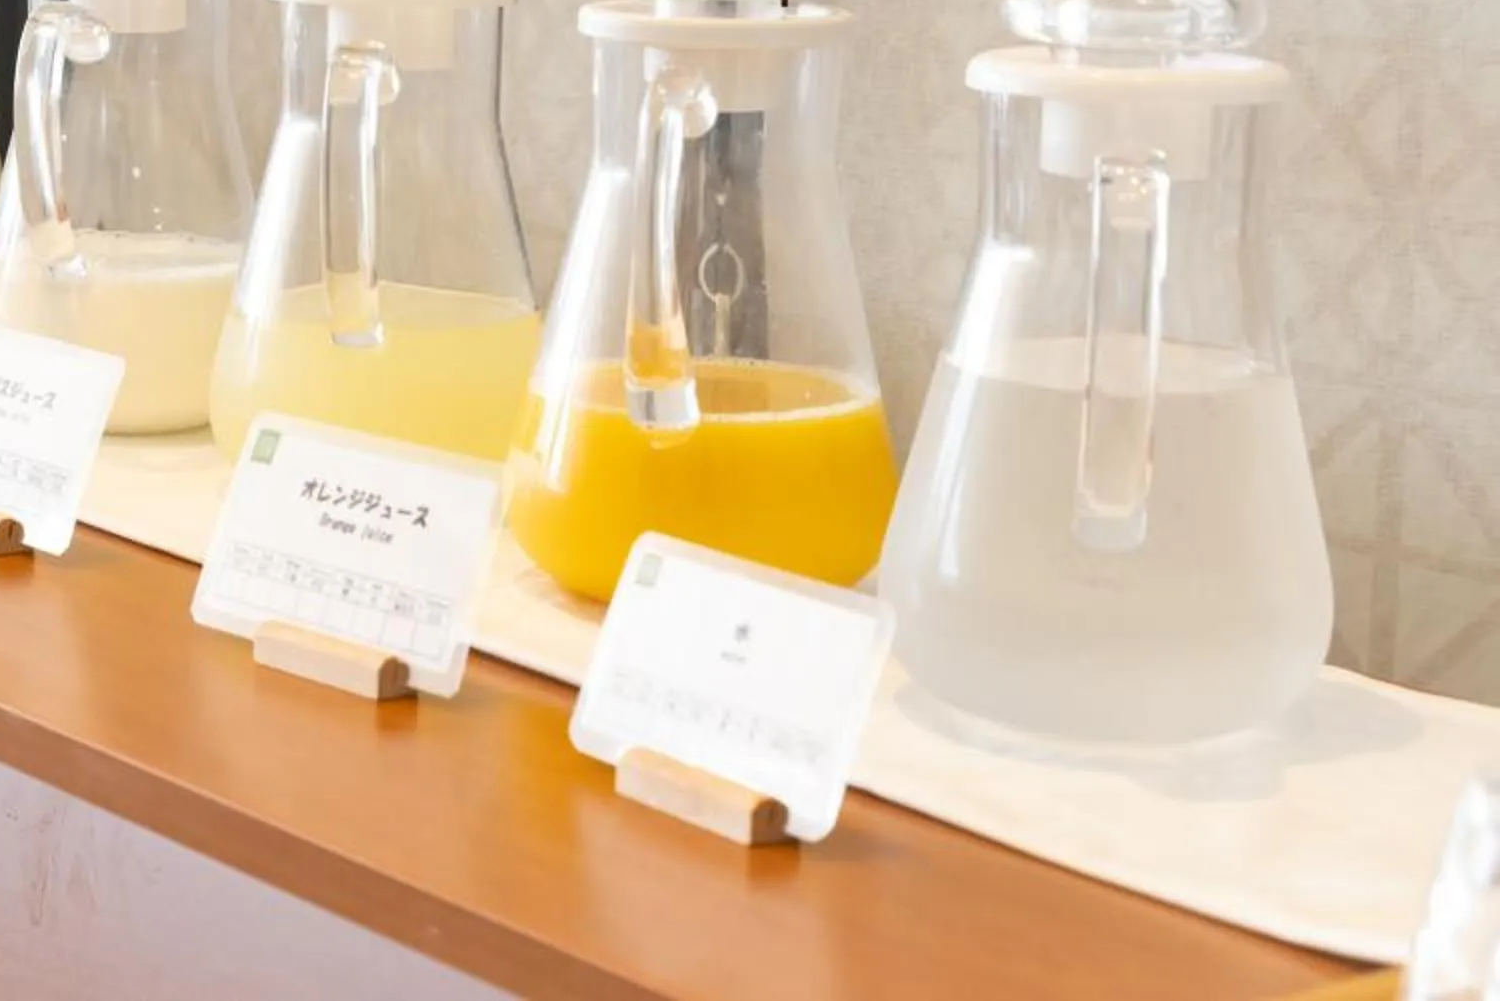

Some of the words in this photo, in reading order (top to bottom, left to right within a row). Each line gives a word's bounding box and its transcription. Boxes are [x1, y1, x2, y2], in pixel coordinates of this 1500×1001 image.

[301, 479, 430, 528] オレンジジュース
